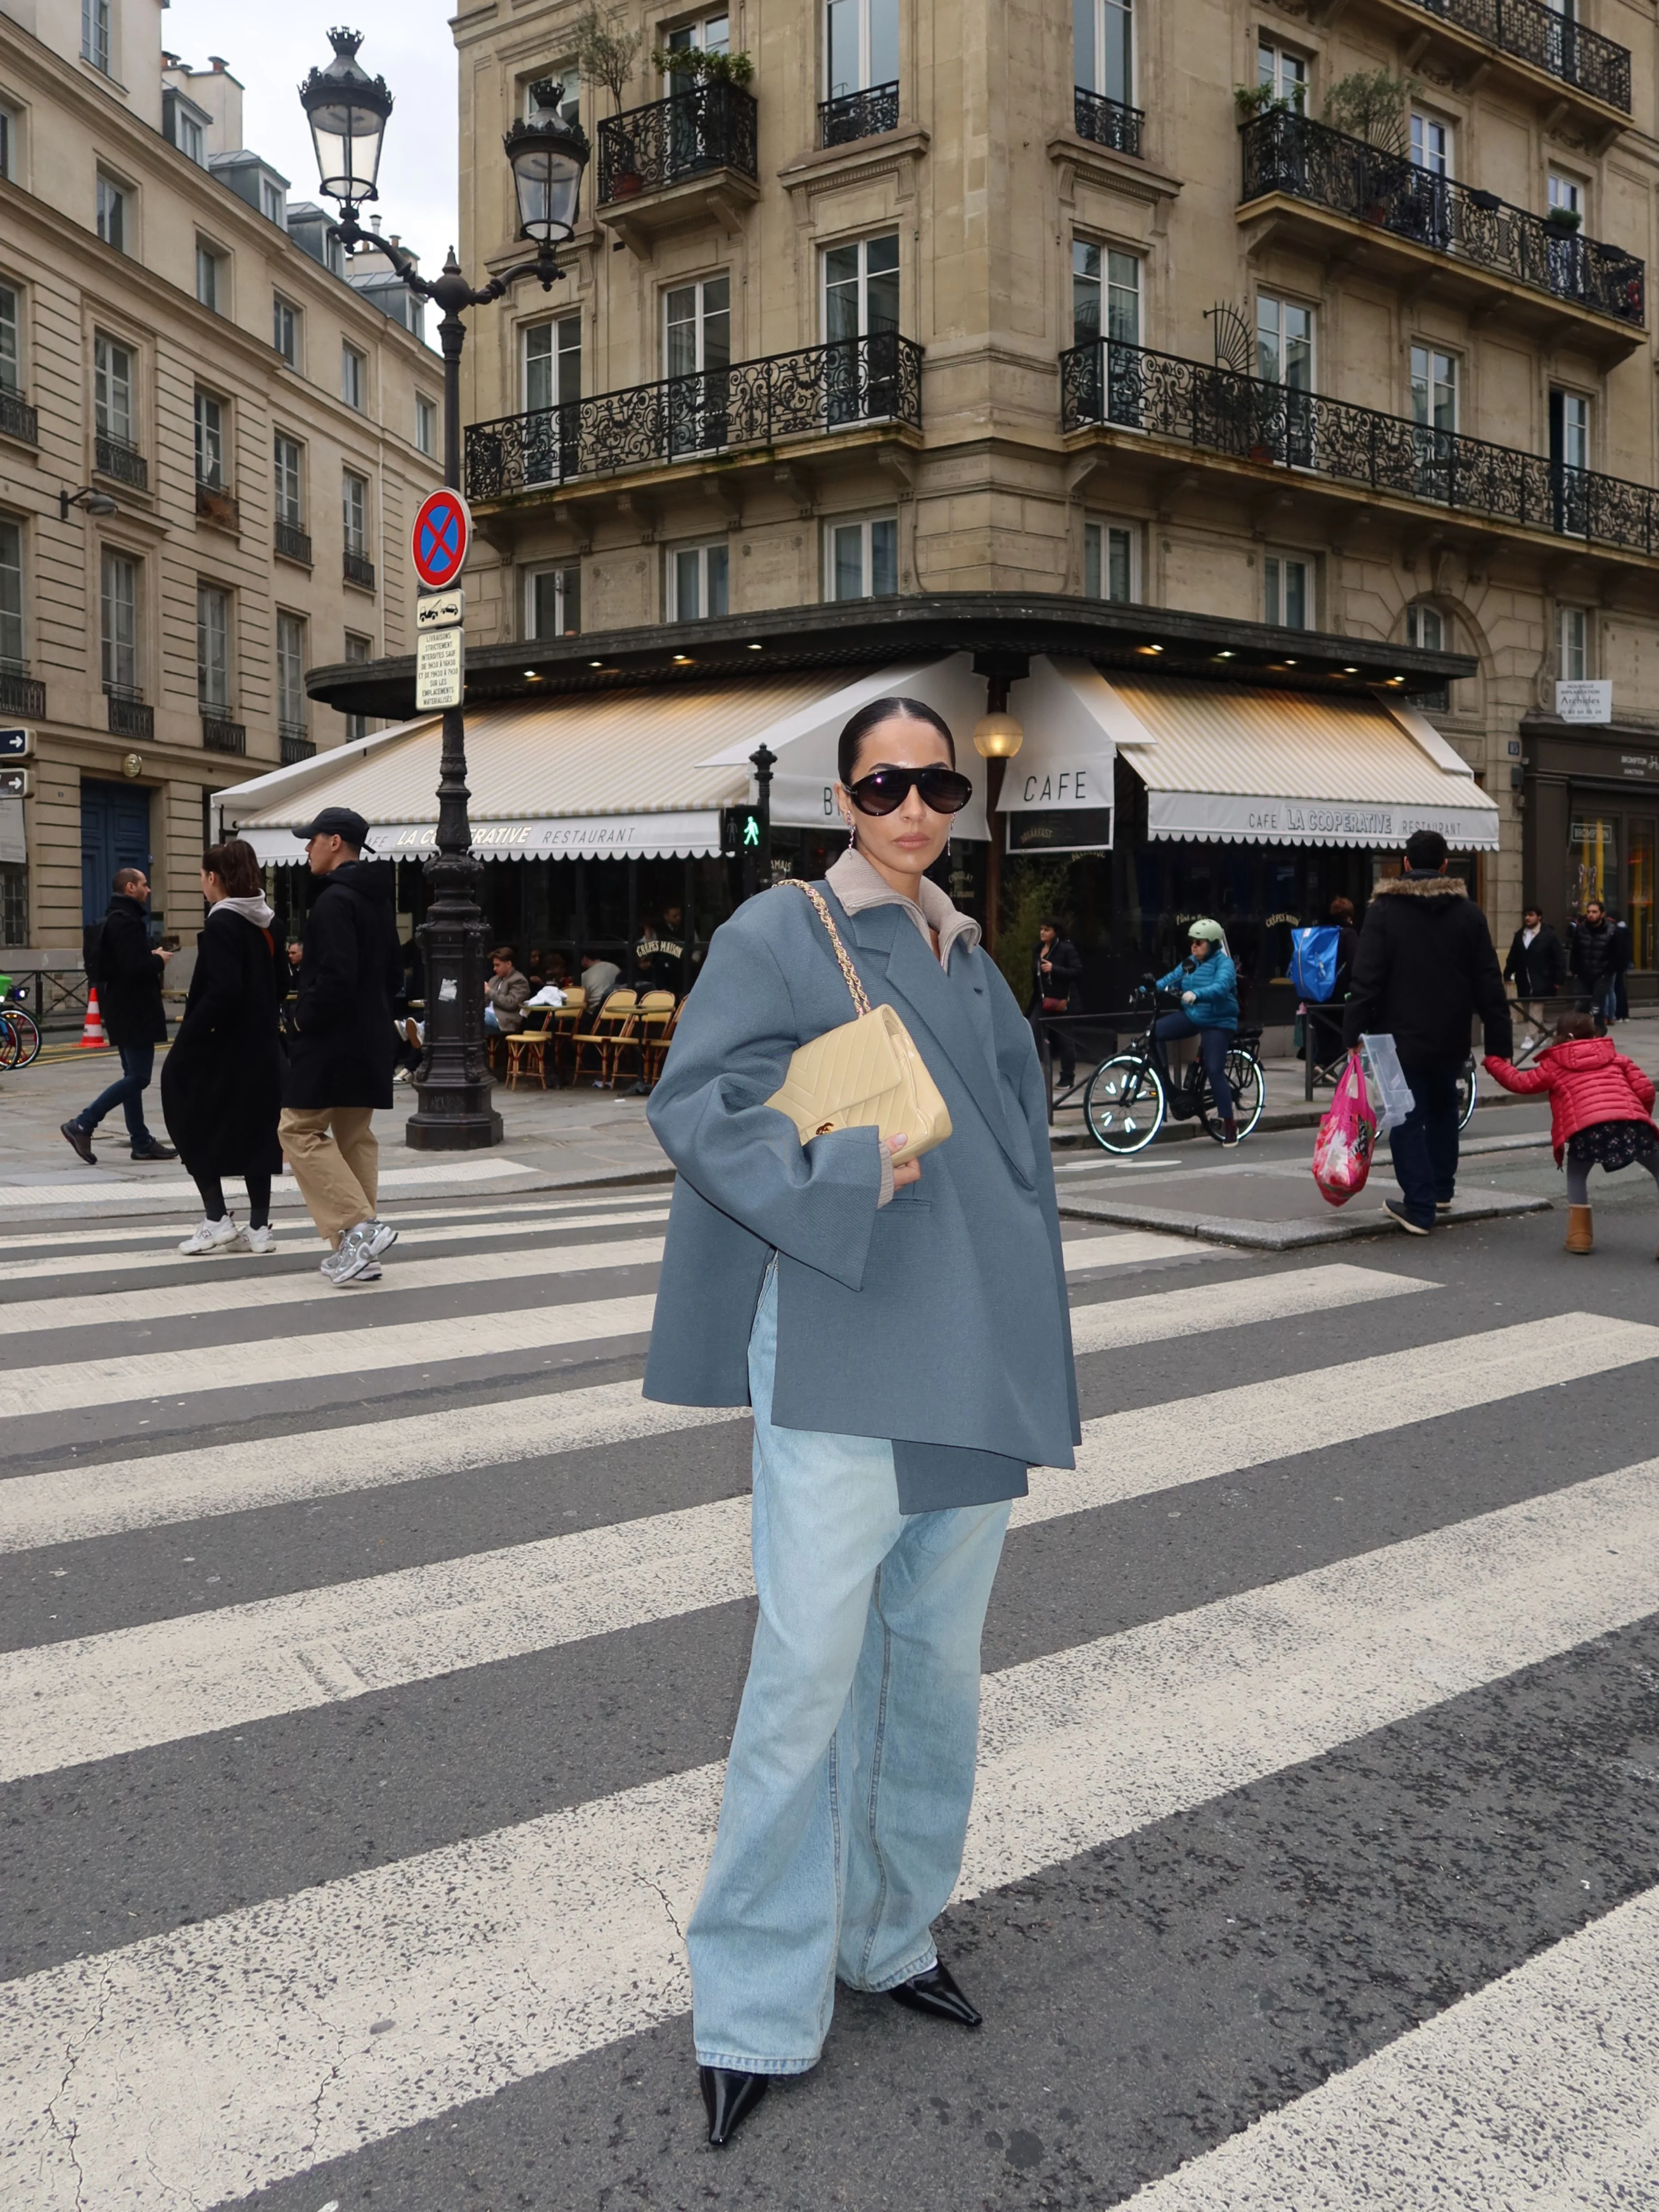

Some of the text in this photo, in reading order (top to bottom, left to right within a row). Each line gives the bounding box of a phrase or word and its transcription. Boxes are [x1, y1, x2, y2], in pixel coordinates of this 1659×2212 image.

[426, 632, 451, 642] LIVRAISONS
[425, 641, 452, 652] STRICTEMENT
[421, 651, 444, 661] INTERDITES
[422, 686, 454, 696] EMPLACEMENTS
[1024, 771, 1086, 801] CAFE
[1249, 813, 1277, 828] CAFE
[1287, 809, 1305, 830] LA
[1309, 810, 1392, 834] COOPERATIVE
[396, 829, 419, 846] LA
[542, 828, 636, 844] RESTAURANT
[1020, 828, 1053, 844] BREAKFAST
[636, 940, 683, 958] CRÊPES MAISON
